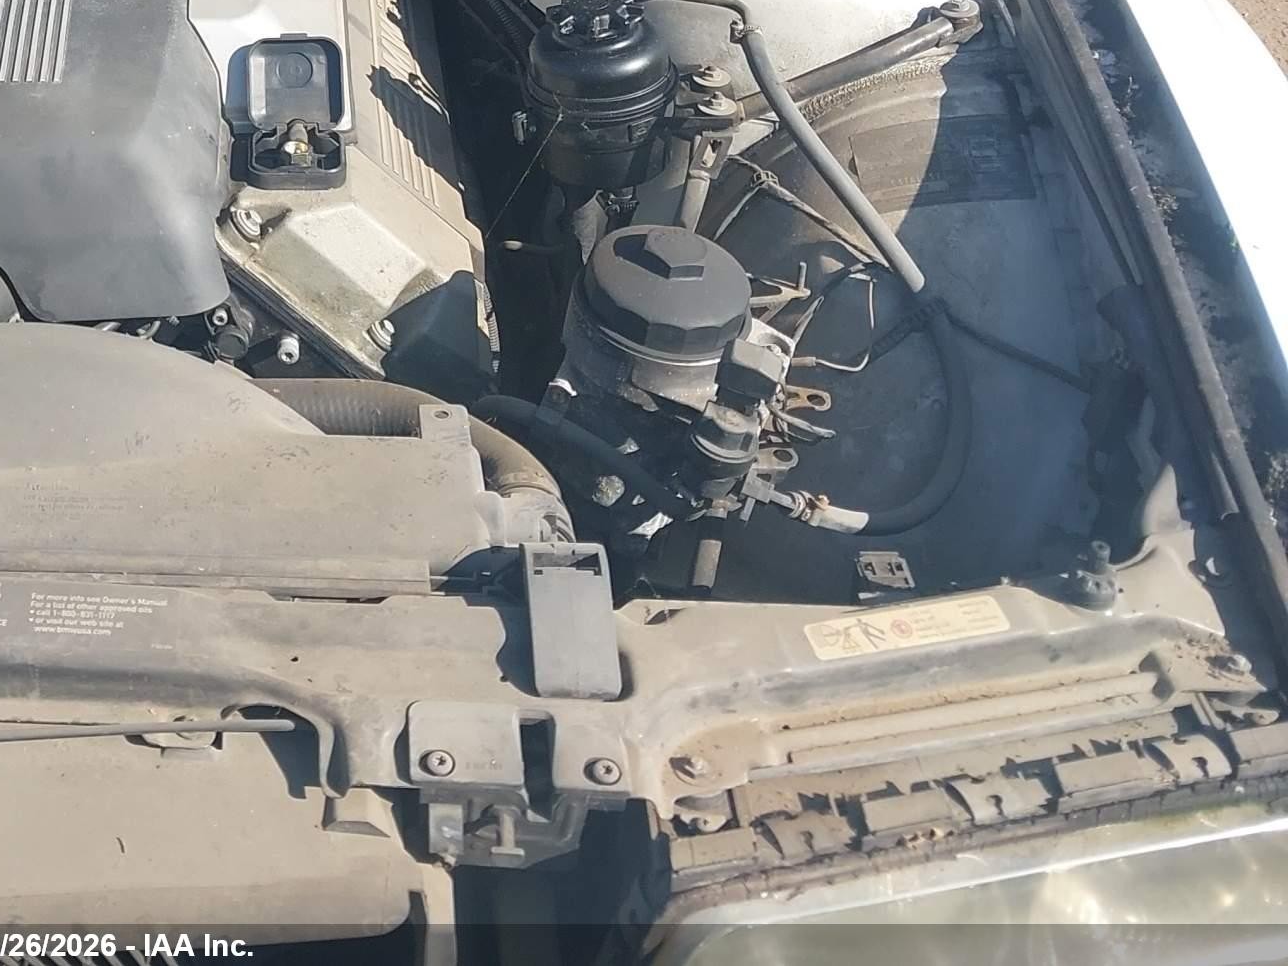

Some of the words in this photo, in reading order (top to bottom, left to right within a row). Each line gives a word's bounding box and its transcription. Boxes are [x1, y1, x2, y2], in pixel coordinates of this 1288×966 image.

[31, 592, 45, 600] For
[137, 598, 168, 606] Manual
[30, 600, 45, 608] For
[52, 601, 65, 609] list
[67, 602, 76, 610] of
[99, 604, 137, 613] approved
[64, 618, 78, 626] our
[80, 619, 98, 627] web
